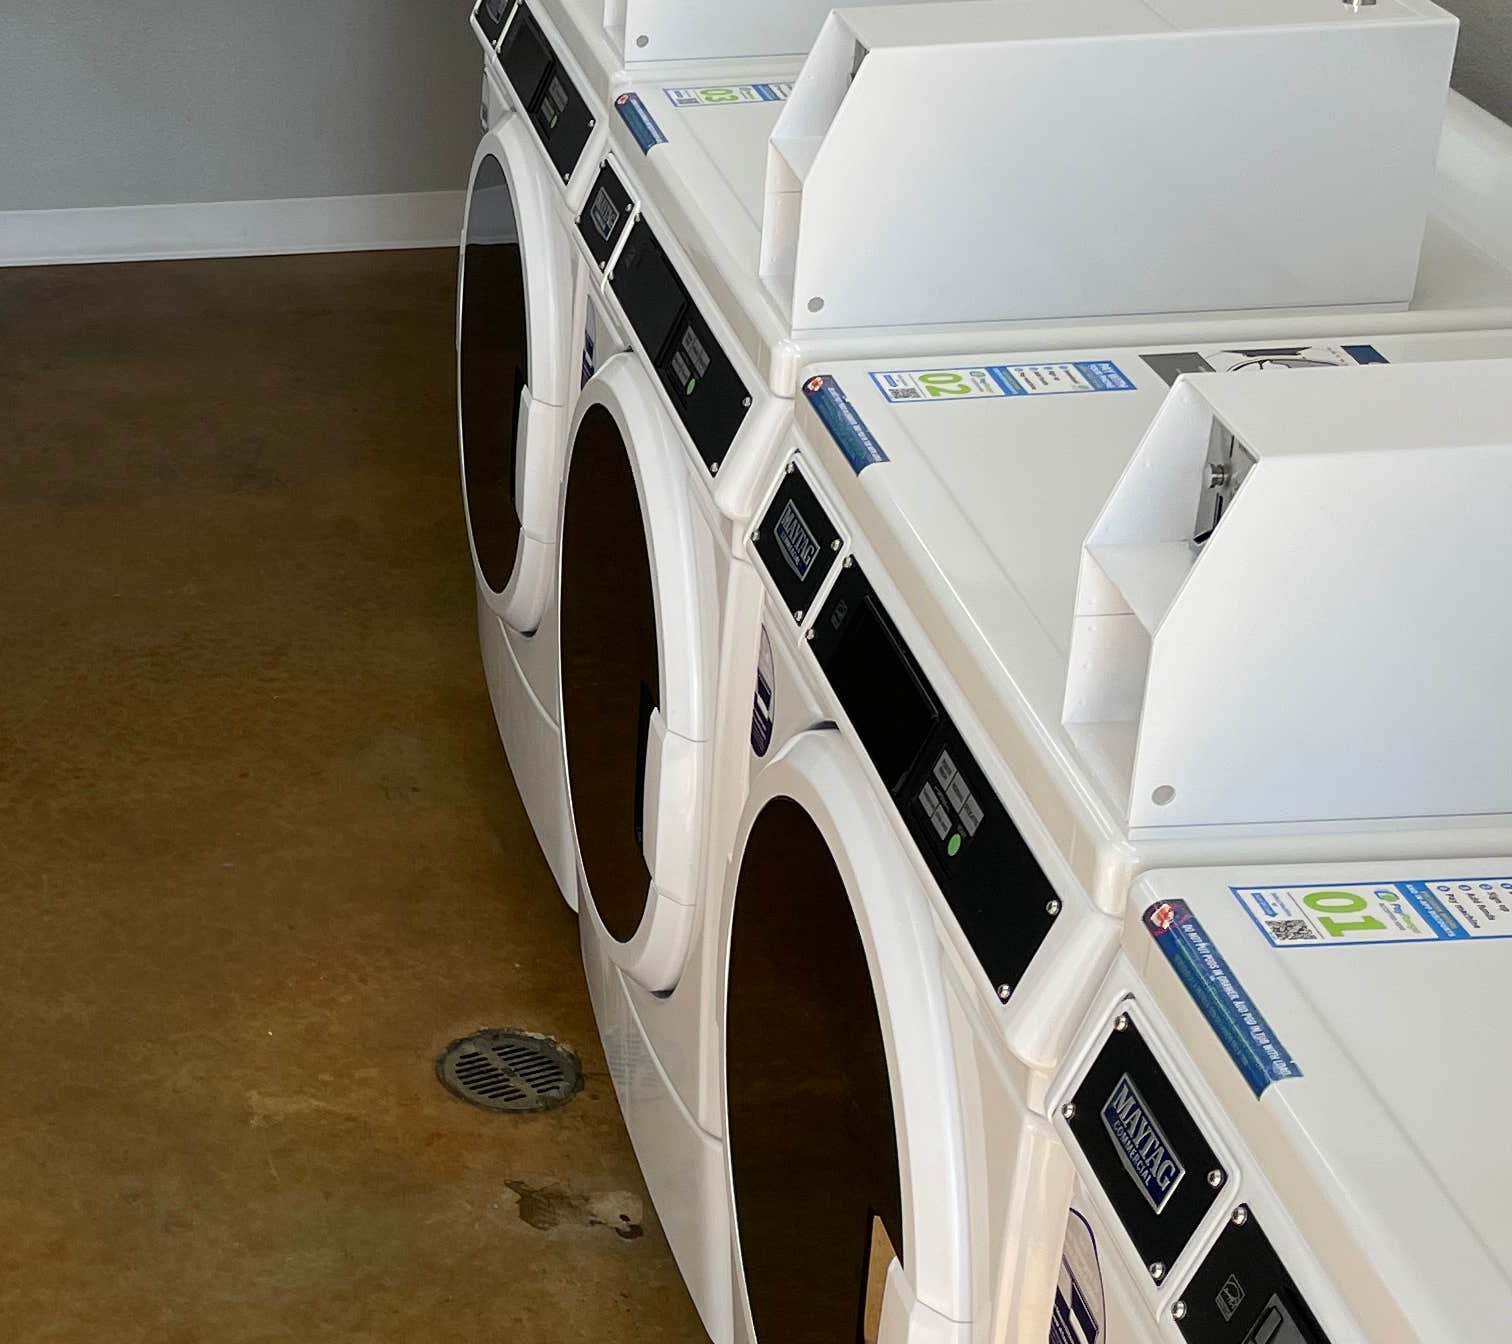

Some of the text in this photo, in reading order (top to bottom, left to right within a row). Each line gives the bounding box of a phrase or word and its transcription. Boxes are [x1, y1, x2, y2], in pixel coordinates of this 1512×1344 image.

[918, 373, 972, 396] 02
[1303, 891, 1387, 937] 01
[1113, 1084, 1176, 1191] MAYTAG
[1114, 1119, 1153, 1186] COMMERCIAL
